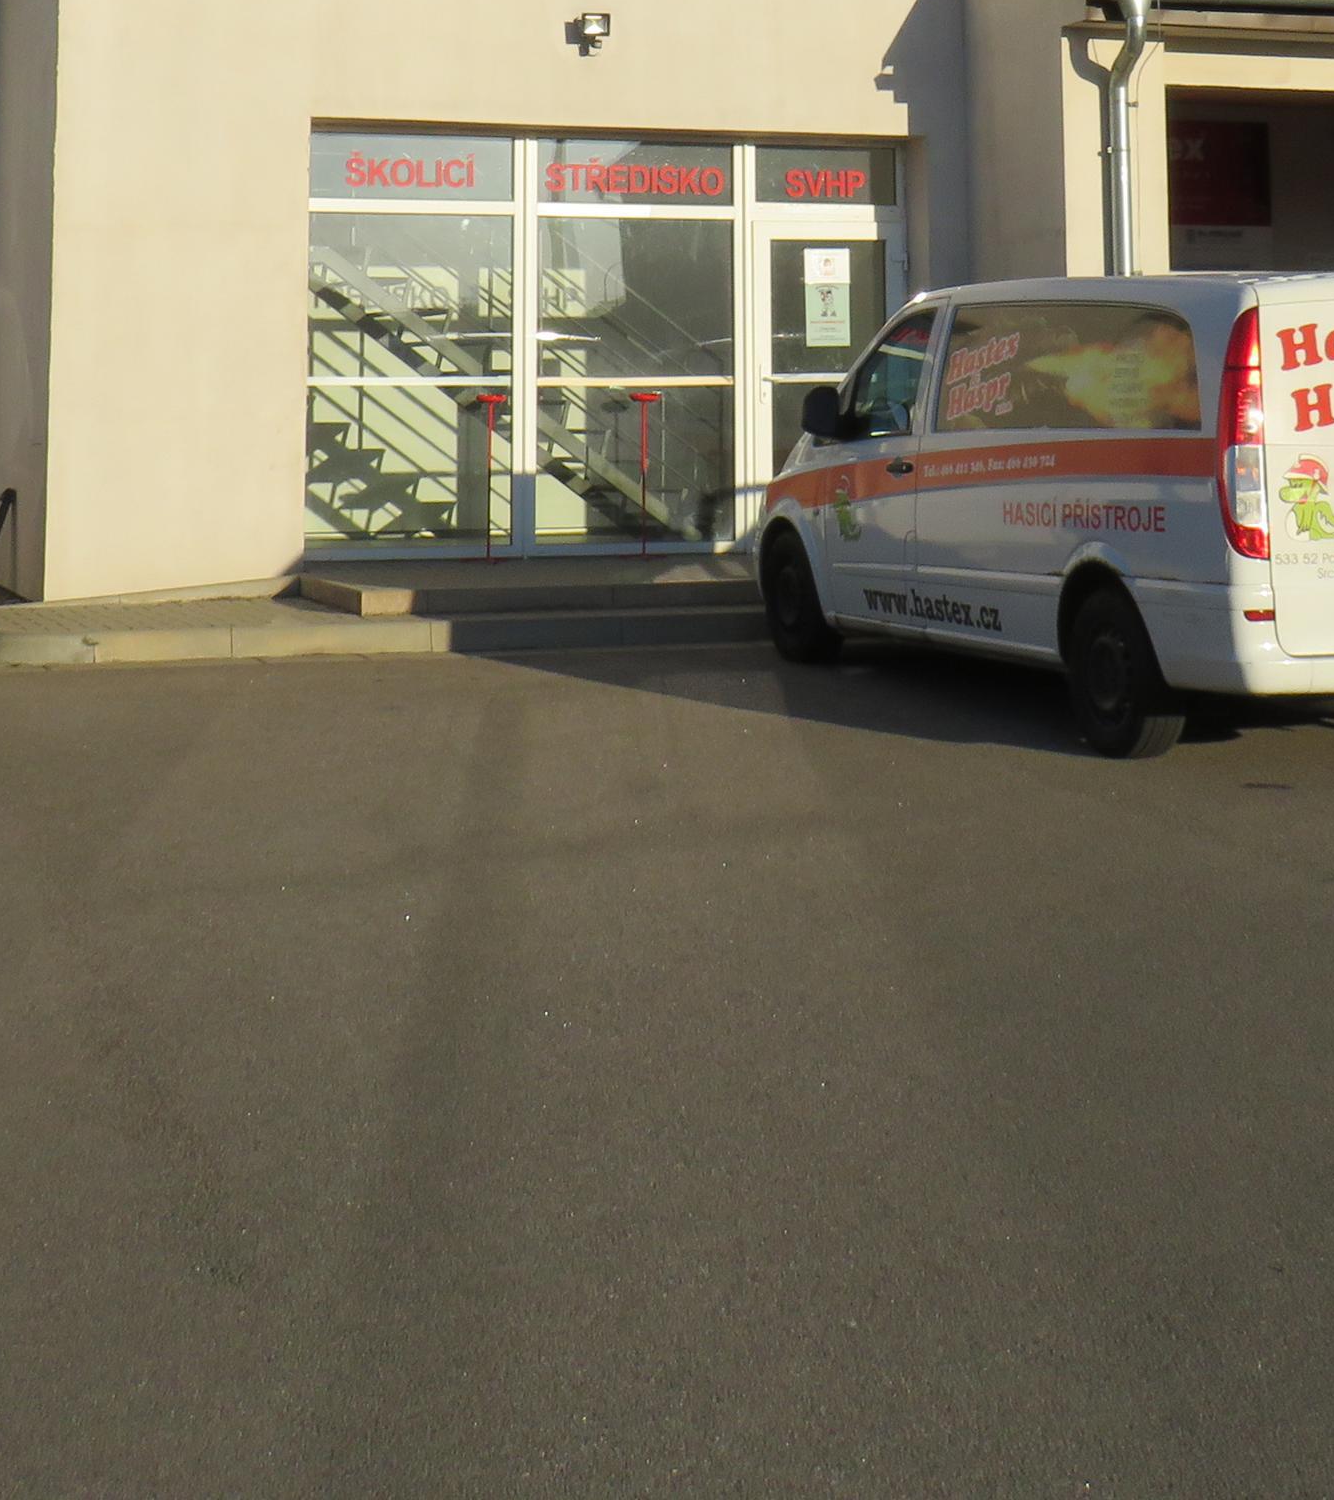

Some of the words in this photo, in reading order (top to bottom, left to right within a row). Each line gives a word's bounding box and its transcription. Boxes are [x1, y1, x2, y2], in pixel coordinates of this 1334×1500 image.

[346, 152, 475, 188] ŠKOLICÍ
[545, 157, 725, 196] STŘEDISKO
[785, 168, 866, 198] SVHP
[946, 332, 1020, 385] Hastex
[947, 371, 1011, 420] Haspr
[1003, 499, 1057, 527] HASICÍ
[1062, 498, 1166, 532] PŘÍSTROJE
[1275, 553, 1299, 564] 533
[1303, 553, 1318, 564] 52
[863, 588, 1002, 632] www.hastex.cz
